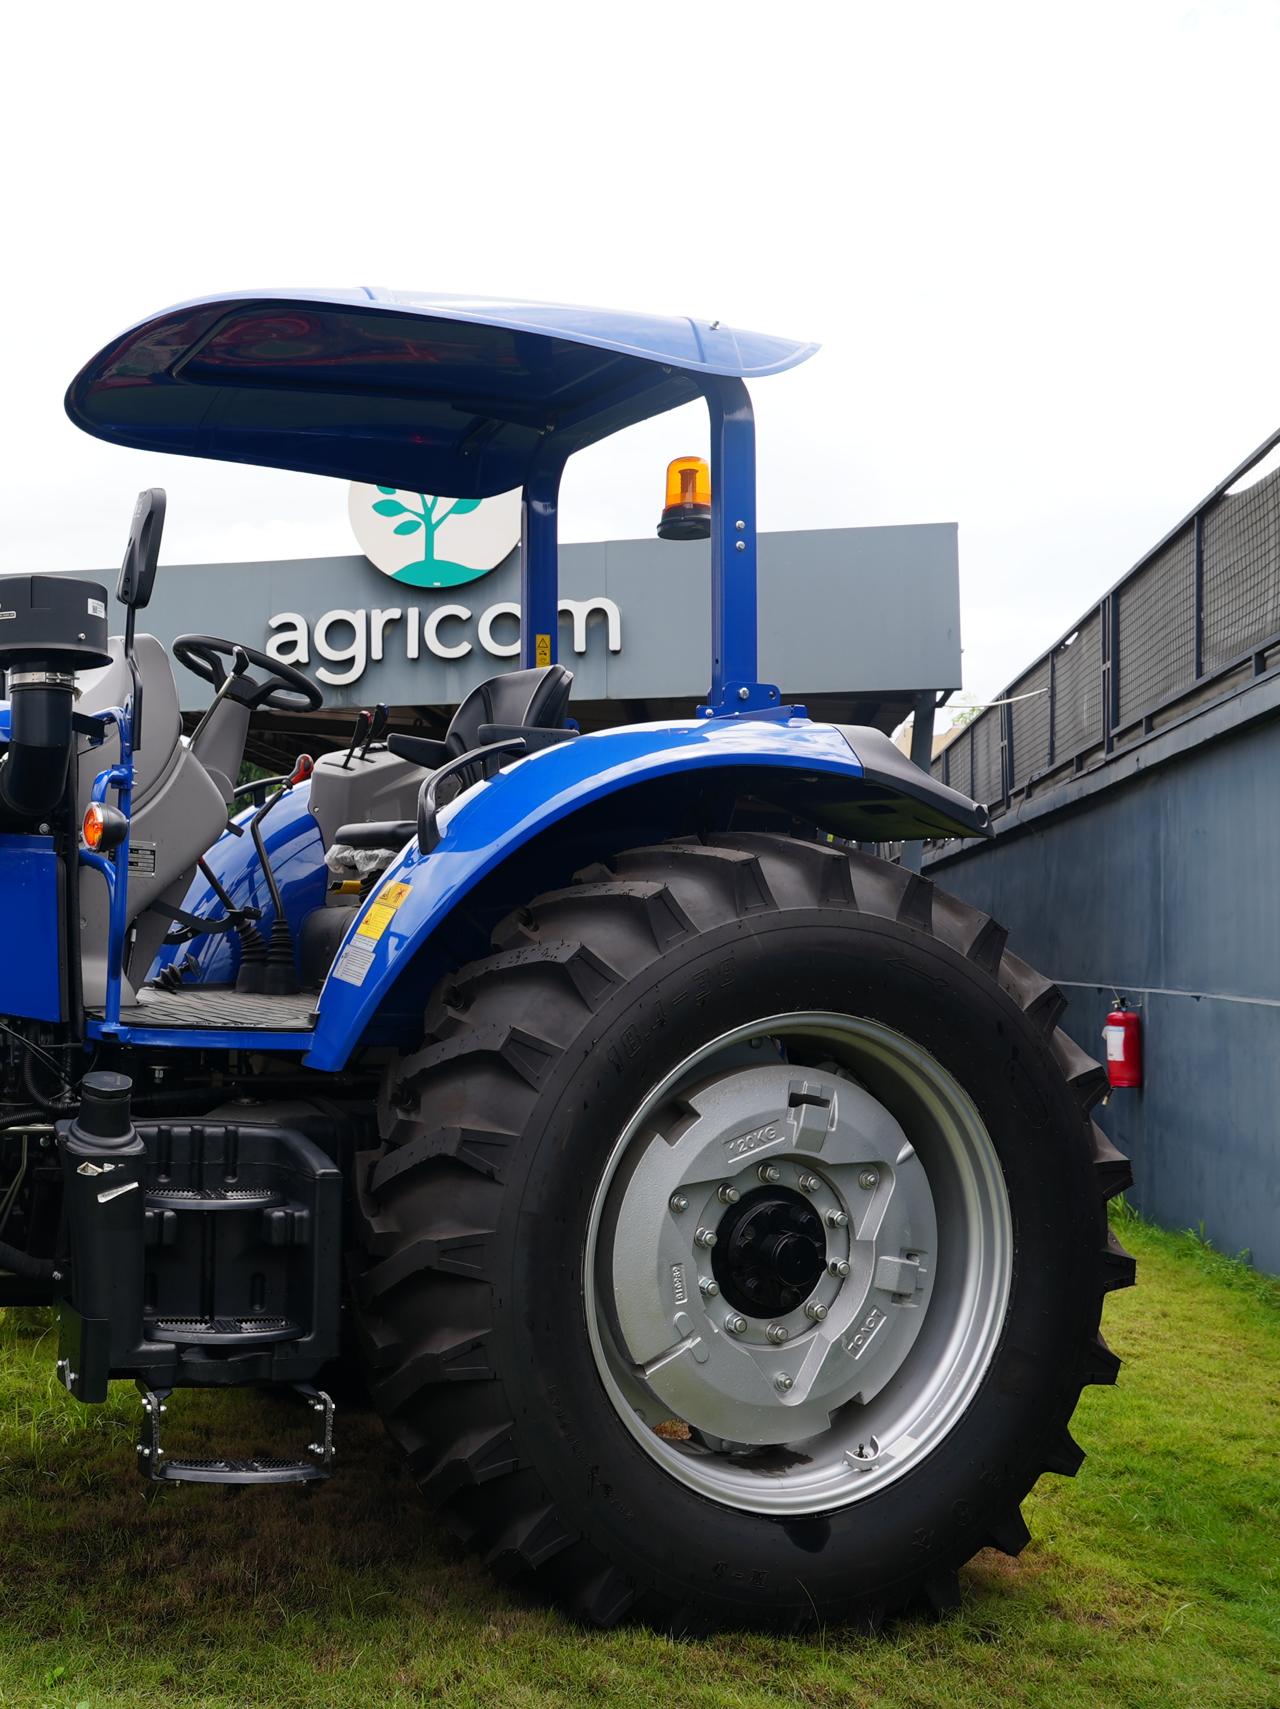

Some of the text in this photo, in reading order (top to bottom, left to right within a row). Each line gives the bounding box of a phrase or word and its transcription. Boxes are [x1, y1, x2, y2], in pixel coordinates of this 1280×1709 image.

[266, 597, 622, 686] agricom
[729, 1126, 776, 1152] 120KG
[847, 1308, 882, 1354] LOVOL
